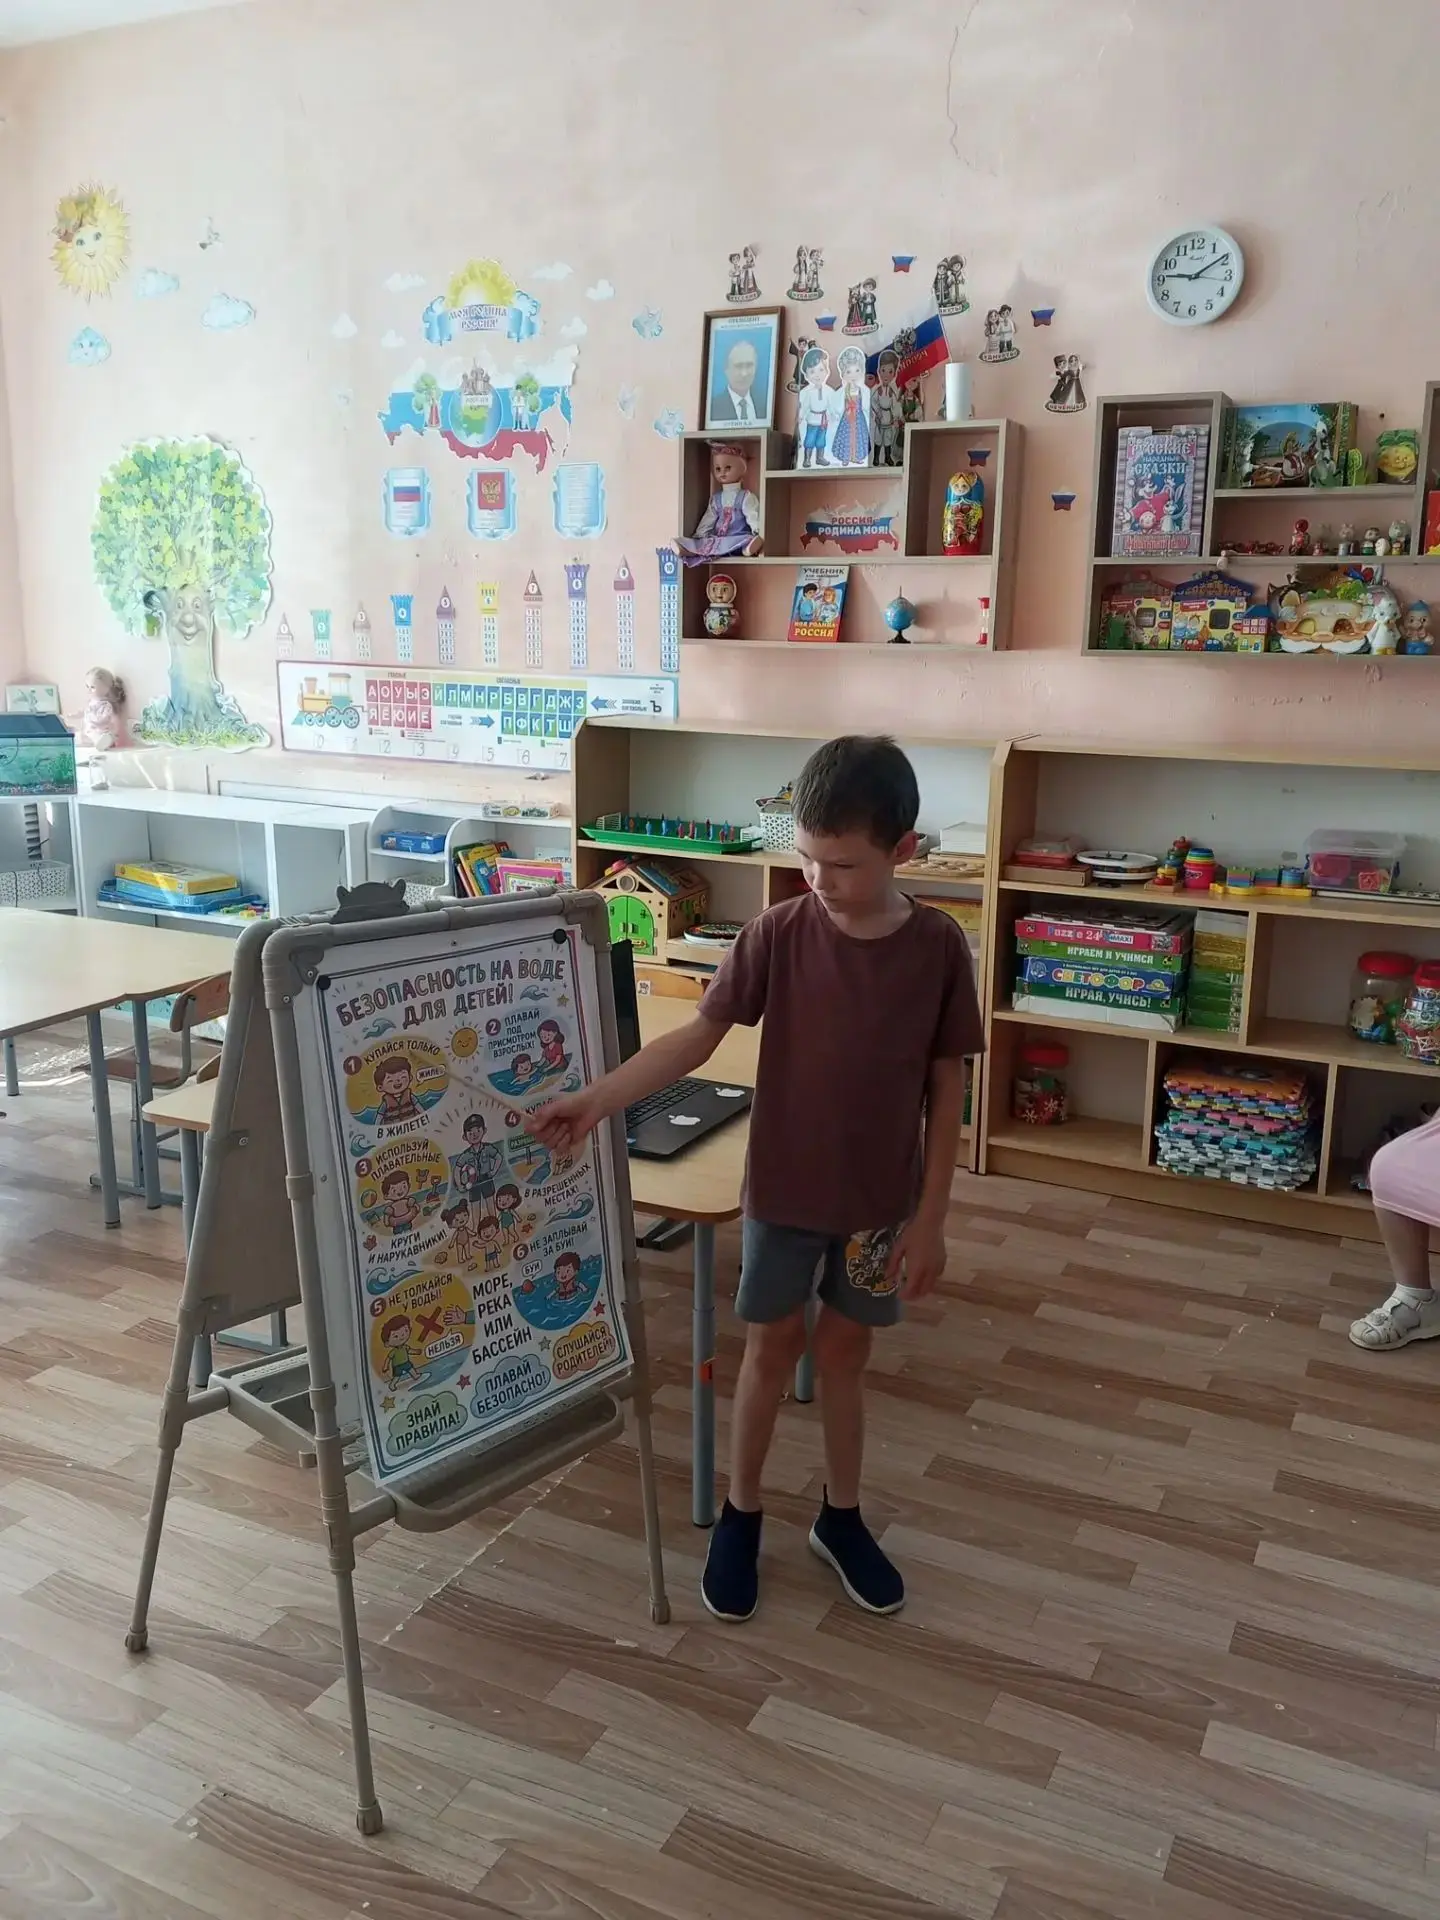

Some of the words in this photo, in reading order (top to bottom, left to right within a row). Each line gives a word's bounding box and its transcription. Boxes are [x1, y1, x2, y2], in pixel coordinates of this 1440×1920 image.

[1176, 245, 1188, 257] 11
[1190, 238, 1205, 250] 12
[1211, 242, 1217, 254] 1
[1163, 258, 1177, 270] 10
[1220, 253, 1230, 266] 2
[1157, 275, 1165, 286] 9
[1224, 269, 1233, 281] 3
[1161, 290, 1170, 301] 8
[1217, 286, 1225, 297] 4
[1173, 301, 1181, 312] 7
[1188, 305, 1196, 316] 6
[1205, 299, 1213, 310] 5
[1131, 440, 1191, 456] РУССКИЕ
[1135, 462, 1187, 474] СКАЗКИ
[832, 516, 873, 525] РОССИЯ
[818, 526, 861, 536] РОДИНА
[863, 525, 888, 535] МОЯ!
[803, 567, 845, 575] УЧЕБНИК
[794, 627, 835, 637] РОССИЯ
[368, 687, 377, 698] А
[381, 686, 389, 698] О
[394, 687, 403, 698] У
[406, 687, 417, 699] Ы
[422, 688, 430, 699] Э
[435, 686, 444, 700] Й
[448, 688, 457, 700] Л
[461, 689, 471, 701] М
[475, 691, 484, 702] Н
[490, 692, 498, 703] Р
[504, 694, 512, 705] Б
[518, 694, 526, 705] В
[533, 694, 540, 706] Г
[545, 694, 556, 706] Д
[559, 695, 572, 706] Ж
[576, 698, 584, 709] З
[650, 700, 662, 712] Ъ
[370, 710, 377, 721] Я
[382, 708, 390, 721] Ё
[393, 710, 405, 722] Ю
[408, 710, 416, 723] И
[422, 711, 429, 723] Е
[504, 717, 512, 728] П
[517, 717, 527, 728] Ф
[532, 718, 540, 729] К
[546, 720, 555, 731] Т
[559, 720, 572, 732] Ш
[1067, 946, 1104, 959] ИГРАЕМ
[1105, 951, 1112, 960] И
[1115, 952, 1153, 965] УЧИМСЯ
[1052, 968, 1145, 991] СВЕТОФОР
[336, 964, 486, 1027] БЕЗОПАСНОСТЬ
[491, 960, 513, 981] НА
[518, 959, 566, 982] ВОДЕ
[1065, 987, 1106, 1003] ИГРАЯ,
[1108, 992, 1151, 1008] УЧИСЬ!
[402, 999, 447, 1029] ДЛЯ
[453, 983, 514, 1017] ДЕТЕЙ!
[488, 1020, 498, 1034] 2
[504, 1008, 540, 1027] ПЛАВАЙ
[507, 1025, 522, 1036] ПОД
[488, 1031, 537, 1050] ПРИСМОТРОМ
[493, 1041, 535, 1058] ВЗРОСЛЫХ!
[347, 1060, 355, 1073] 1
[363, 1040, 405, 1065] КУПАЙСЯ
[407, 1040, 440, 1056] ТОЛЬКО
[377, 1127, 384, 1139] В
[386, 1114, 431, 1138] ЖИЛЕТЕ!
[508, 1112, 517, 1123] 4
[359, 1160, 368, 1175] 3
[376, 1138, 429, 1165] ИСПОЛЬЗУЙ
[371, 1152, 442, 1181] ПЛАВАТЕЛЬНЫЕ
[524, 1189, 530, 1198] В
[532, 1162, 591, 1198] РАЗРЕШЕННЫХ
[544, 1185, 579, 1207] МЕСТАХ!
[368, 1253, 375, 1264] И
[377, 1229, 447, 1264] НАРУКАВНИКИ!
[391, 1231, 421, 1249] КРУГИ
[516, 1246, 525, 1259] 6
[530, 1239, 541, 1252] НЕ
[543, 1221, 588, 1246] ЗАПЛЫВАЙ
[543, 1246, 554, 1257] ЗА
[374, 1300, 382, 1314] 5
[388, 1293, 401, 1308] НЕ
[403, 1273, 453, 1299] ТОЛКАЙСЯ
[472, 1273, 513, 1300] МОРЕ,
[402, 1302, 409, 1313] У
[478, 1294, 512, 1319] РЕКА
[484, 1314, 514, 1338] ИЛИ
[428, 1335, 461, 1356] НЕЛЬЗЯ
[472, 1326, 532, 1365] БАССЕЙН
[556, 1328, 607, 1358] СЛУШАЙСЯ
[556, 1339, 613, 1375] РОДИТЕЛЕЙ!
[485, 1359, 532, 1393] ПЛАВАЙ
[477, 1373, 547, 1415] БЕЗОПАСНО!
[406, 1400, 441, 1428] ЗНАЙ
[395, 1412, 460, 1451] ПРАВИЛА!
